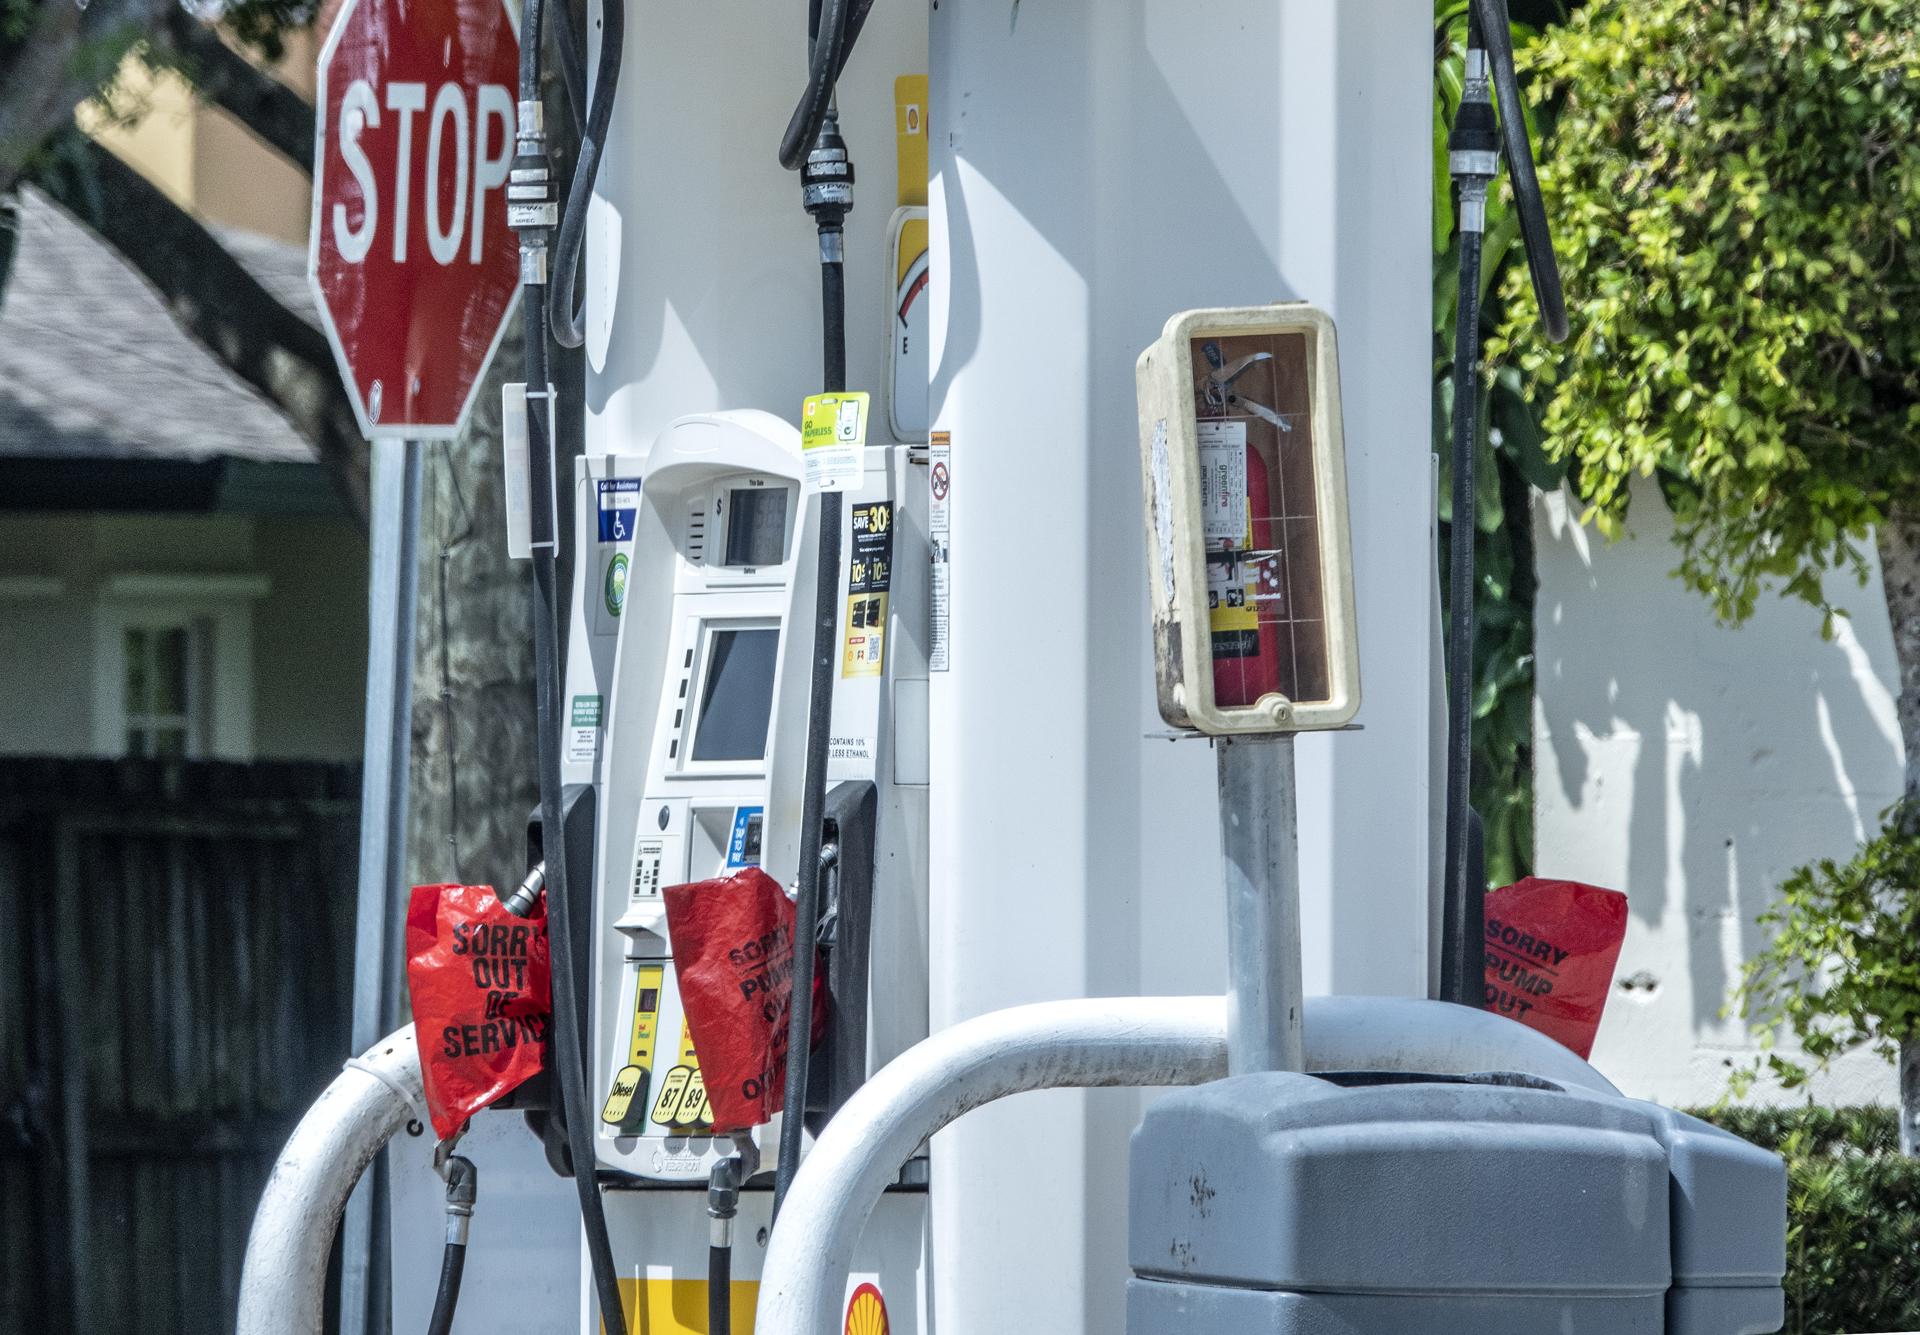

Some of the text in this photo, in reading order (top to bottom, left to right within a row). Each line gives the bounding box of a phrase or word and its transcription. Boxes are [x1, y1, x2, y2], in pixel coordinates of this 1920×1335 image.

[333, 79, 517, 266] STOP
[903, 336, 908, 355] E
[804, 420, 813, 430] GO
[804, 426, 833, 438] PAPERLESS
[1219, 464, 1230, 508] greenfire
[853, 516, 869, 530] SAVE
[830, 737, 854, 746] CONTAINS
[832, 748, 845, 758] LESS
[846, 748, 870, 759] ETHANOL
[1486, 919, 1569, 965] SORRY
[472, 956, 528, 991] OUT
[1485, 953, 1553, 997] PUMP
[485, 989, 519, 1021] OF
[1485, 983, 1534, 1020] OUT
[612, 1082, 636, 1098] Diesel
[661, 1088, 679, 1108] 87
[685, 1088, 703, 1109] 89
